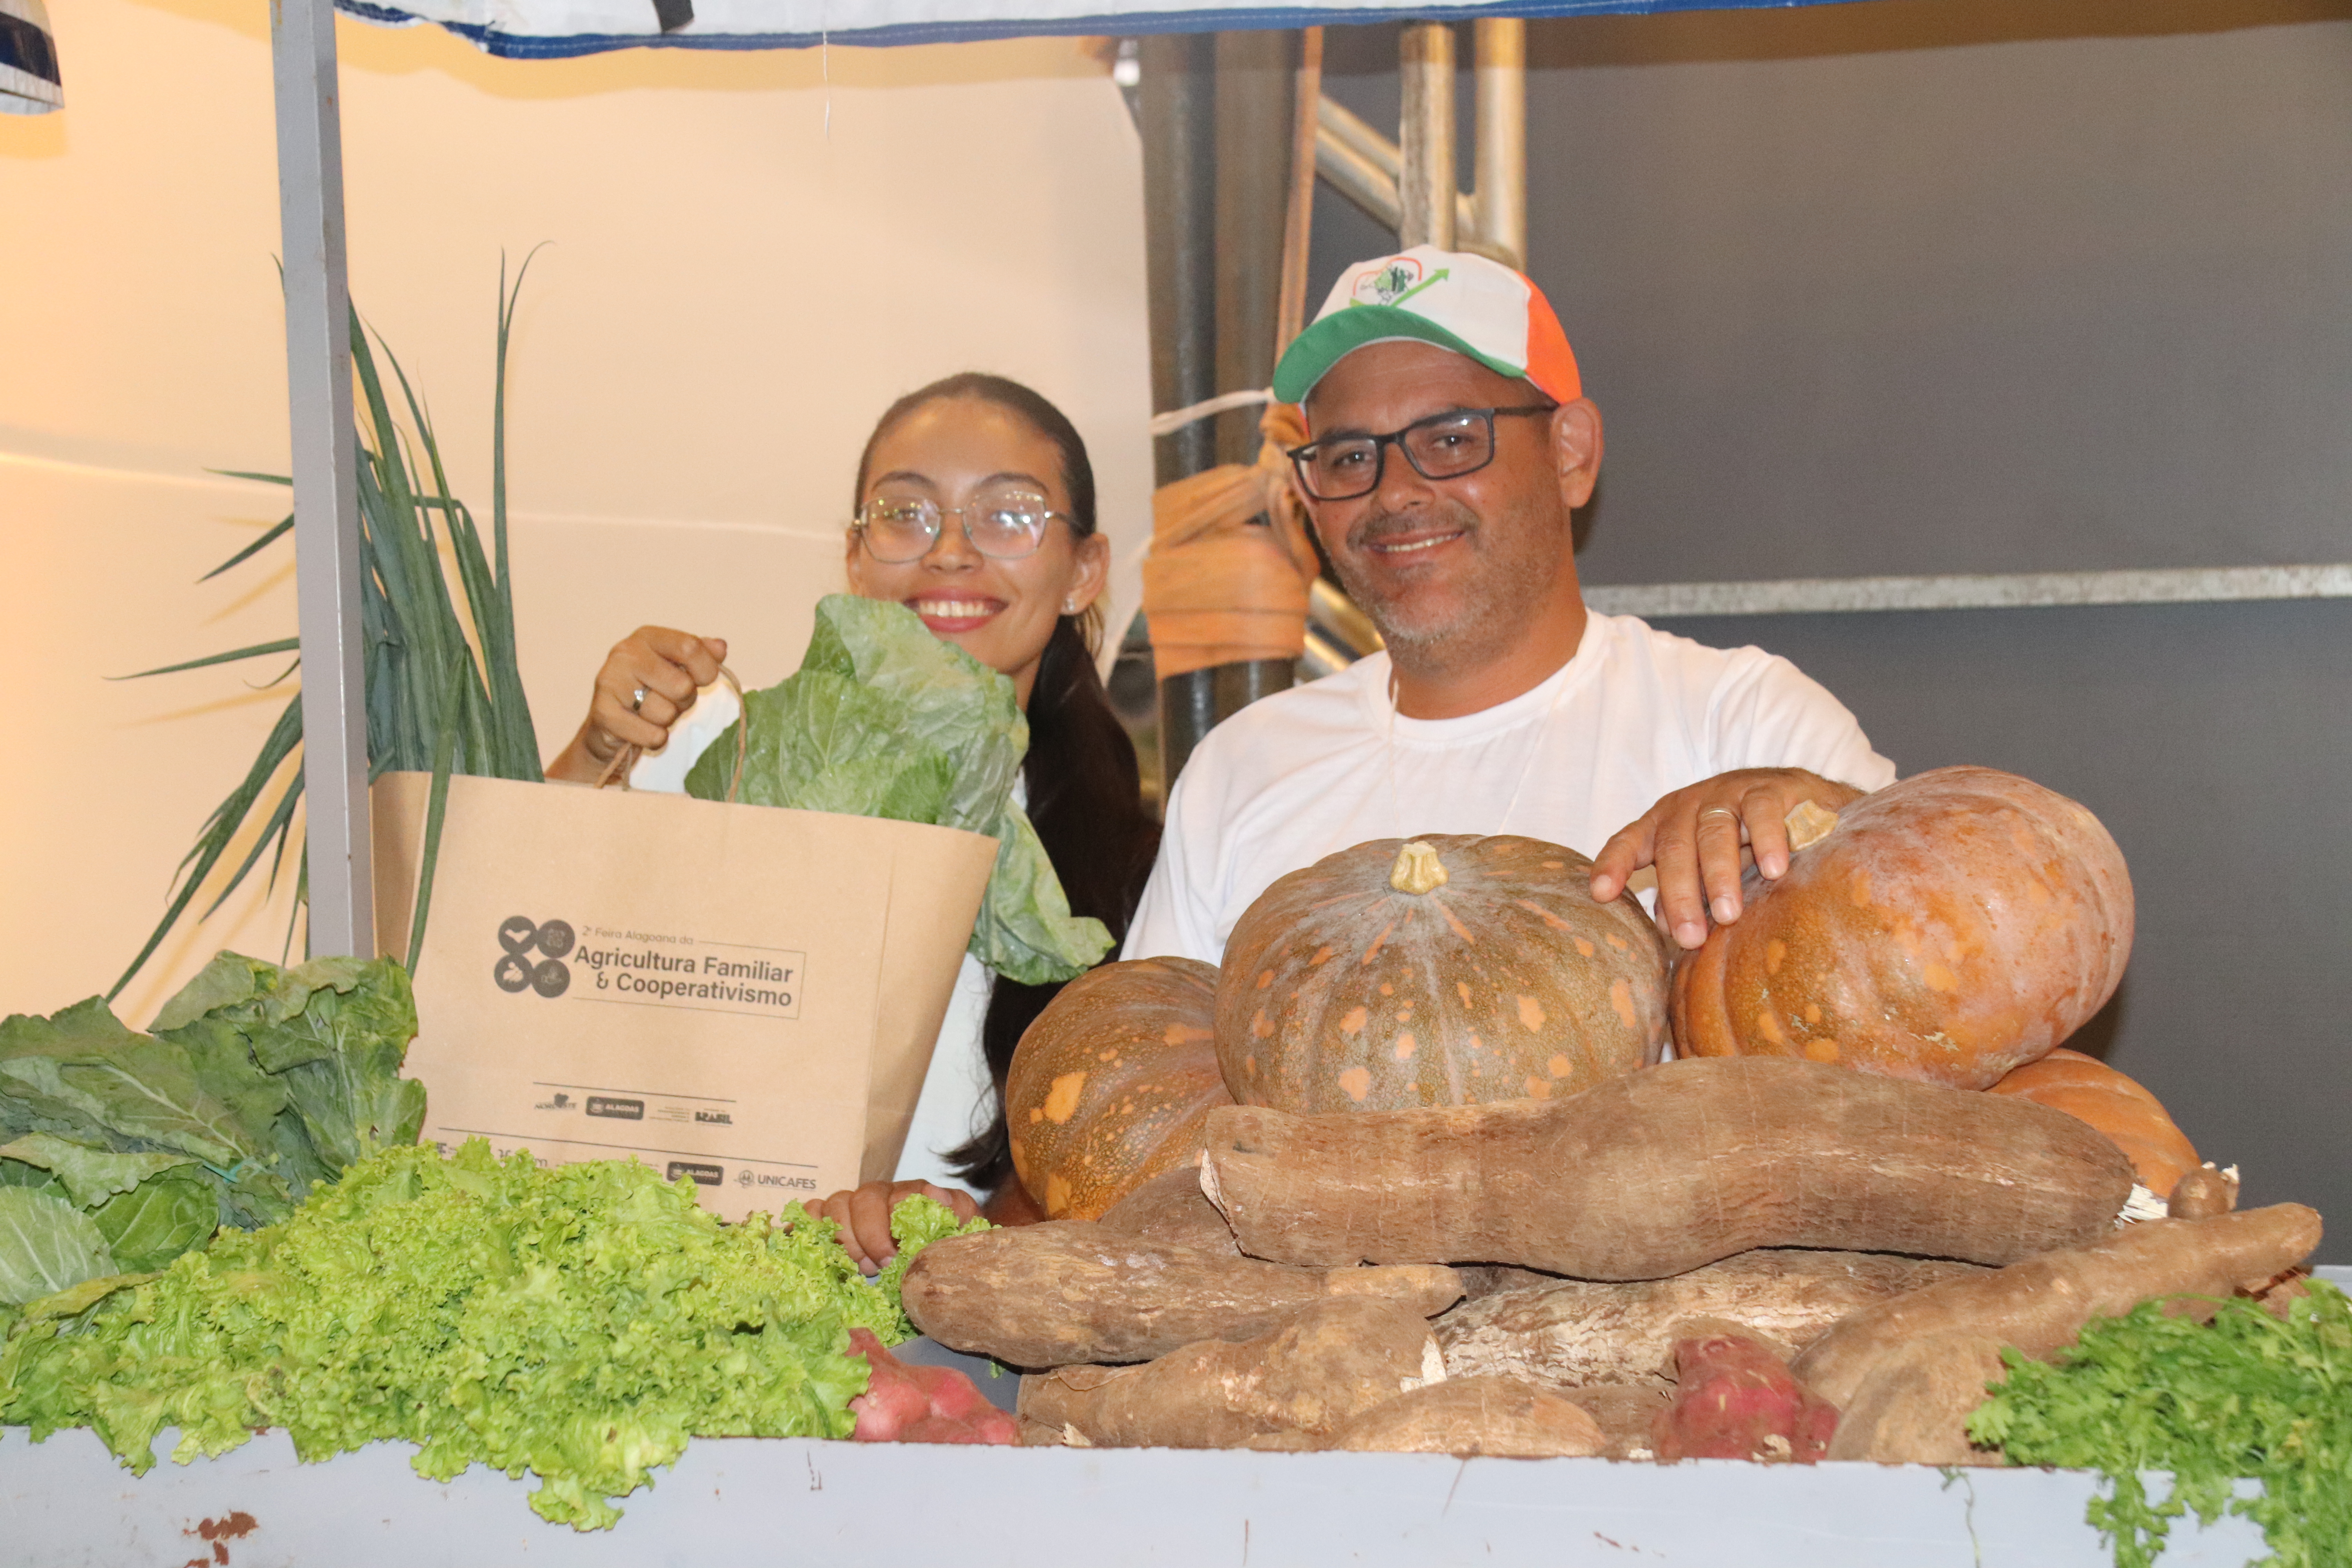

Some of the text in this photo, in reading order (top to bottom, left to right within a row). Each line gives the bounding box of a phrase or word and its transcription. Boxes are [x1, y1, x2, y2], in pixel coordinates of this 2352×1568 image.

[595, 927, 622, 938] Feira
[626, 931, 676, 943] Alagoana
[679, 935, 693, 945] da
[574, 945, 793, 982] Agricultura Familiar
[596, 971, 792, 1007] & Cooperativismo
[606, 1103, 639, 1112] ALAGOAS
[686, 1169, 719, 1178] ALAGOAS
[758, 1174, 816, 1189] UNICAFES
